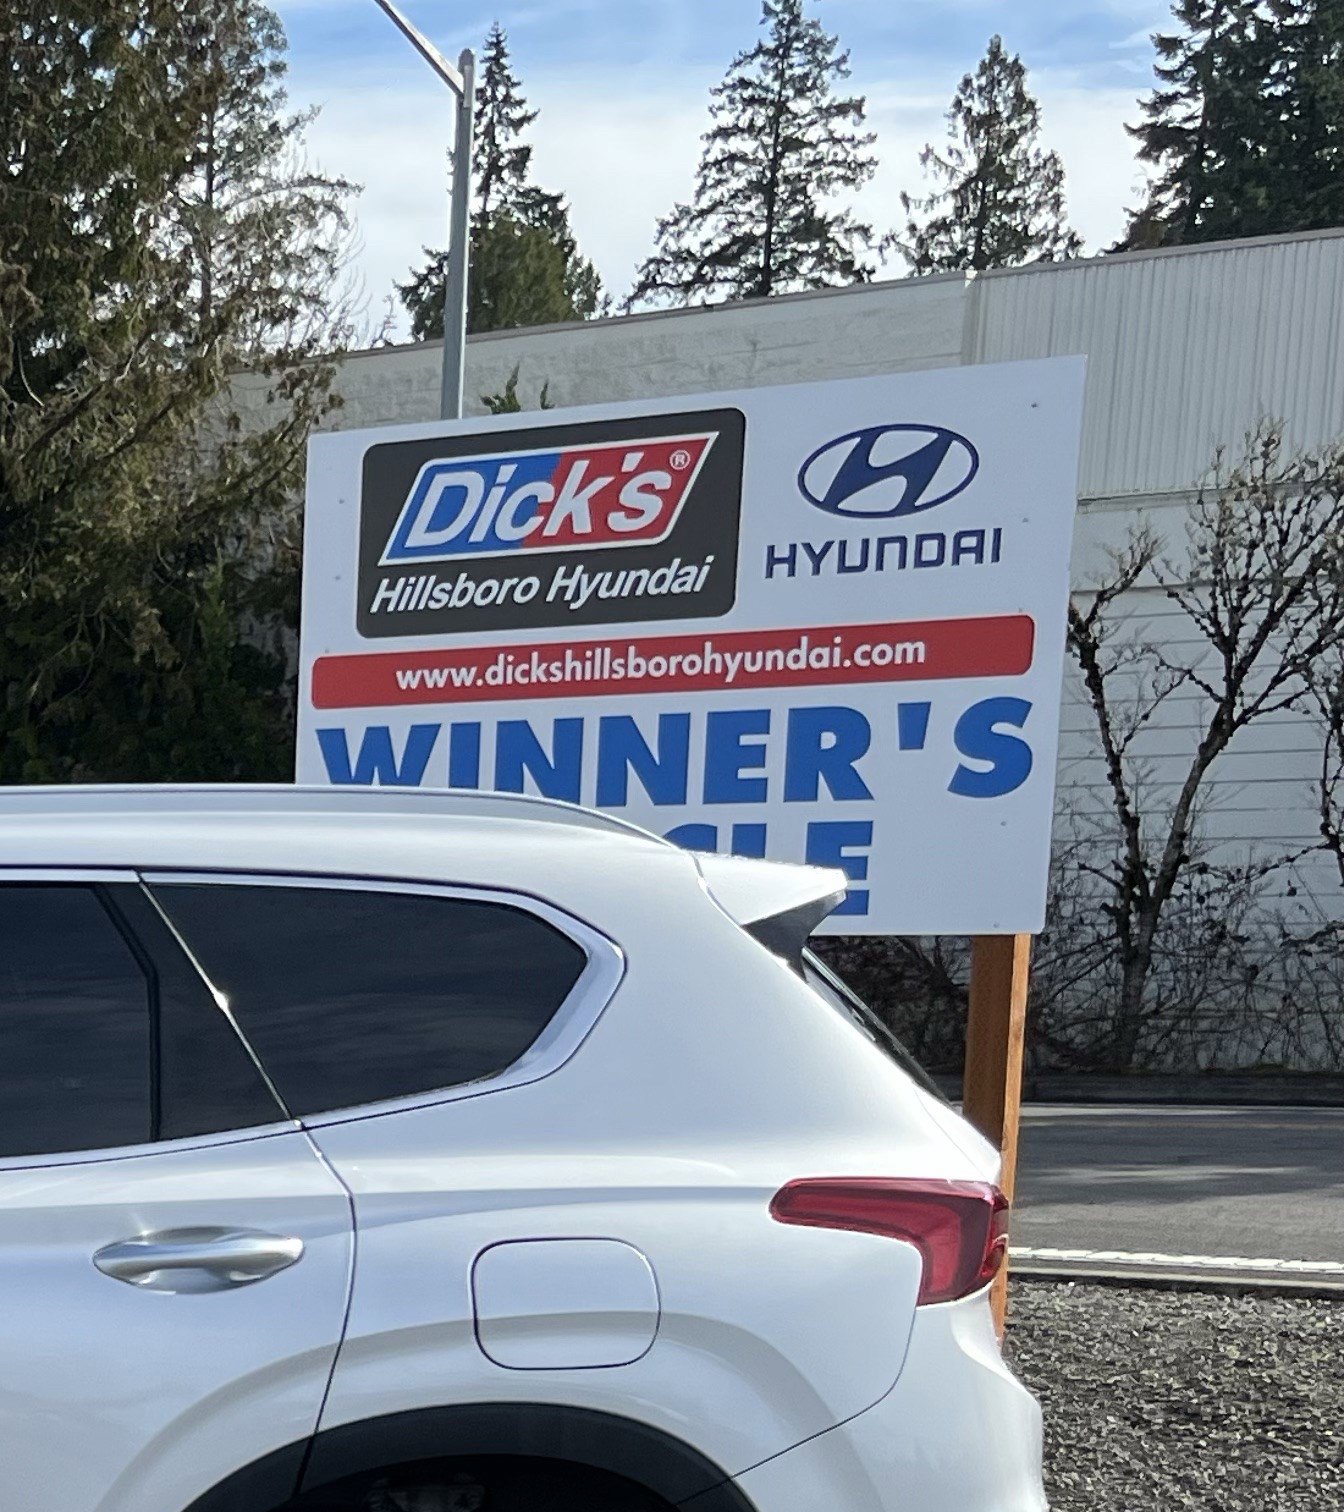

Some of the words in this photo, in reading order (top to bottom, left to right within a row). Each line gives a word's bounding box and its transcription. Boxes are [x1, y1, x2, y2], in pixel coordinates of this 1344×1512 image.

[765, 526, 1004, 579] HYUNDAI
[369, 572, 540, 615] Hillsboro
[545, 555, 715, 611] Hyundai
[395, 635, 927, 690] www.dickshillsborohyundai.com
[315, 696, 1034, 808] WINNER'S
